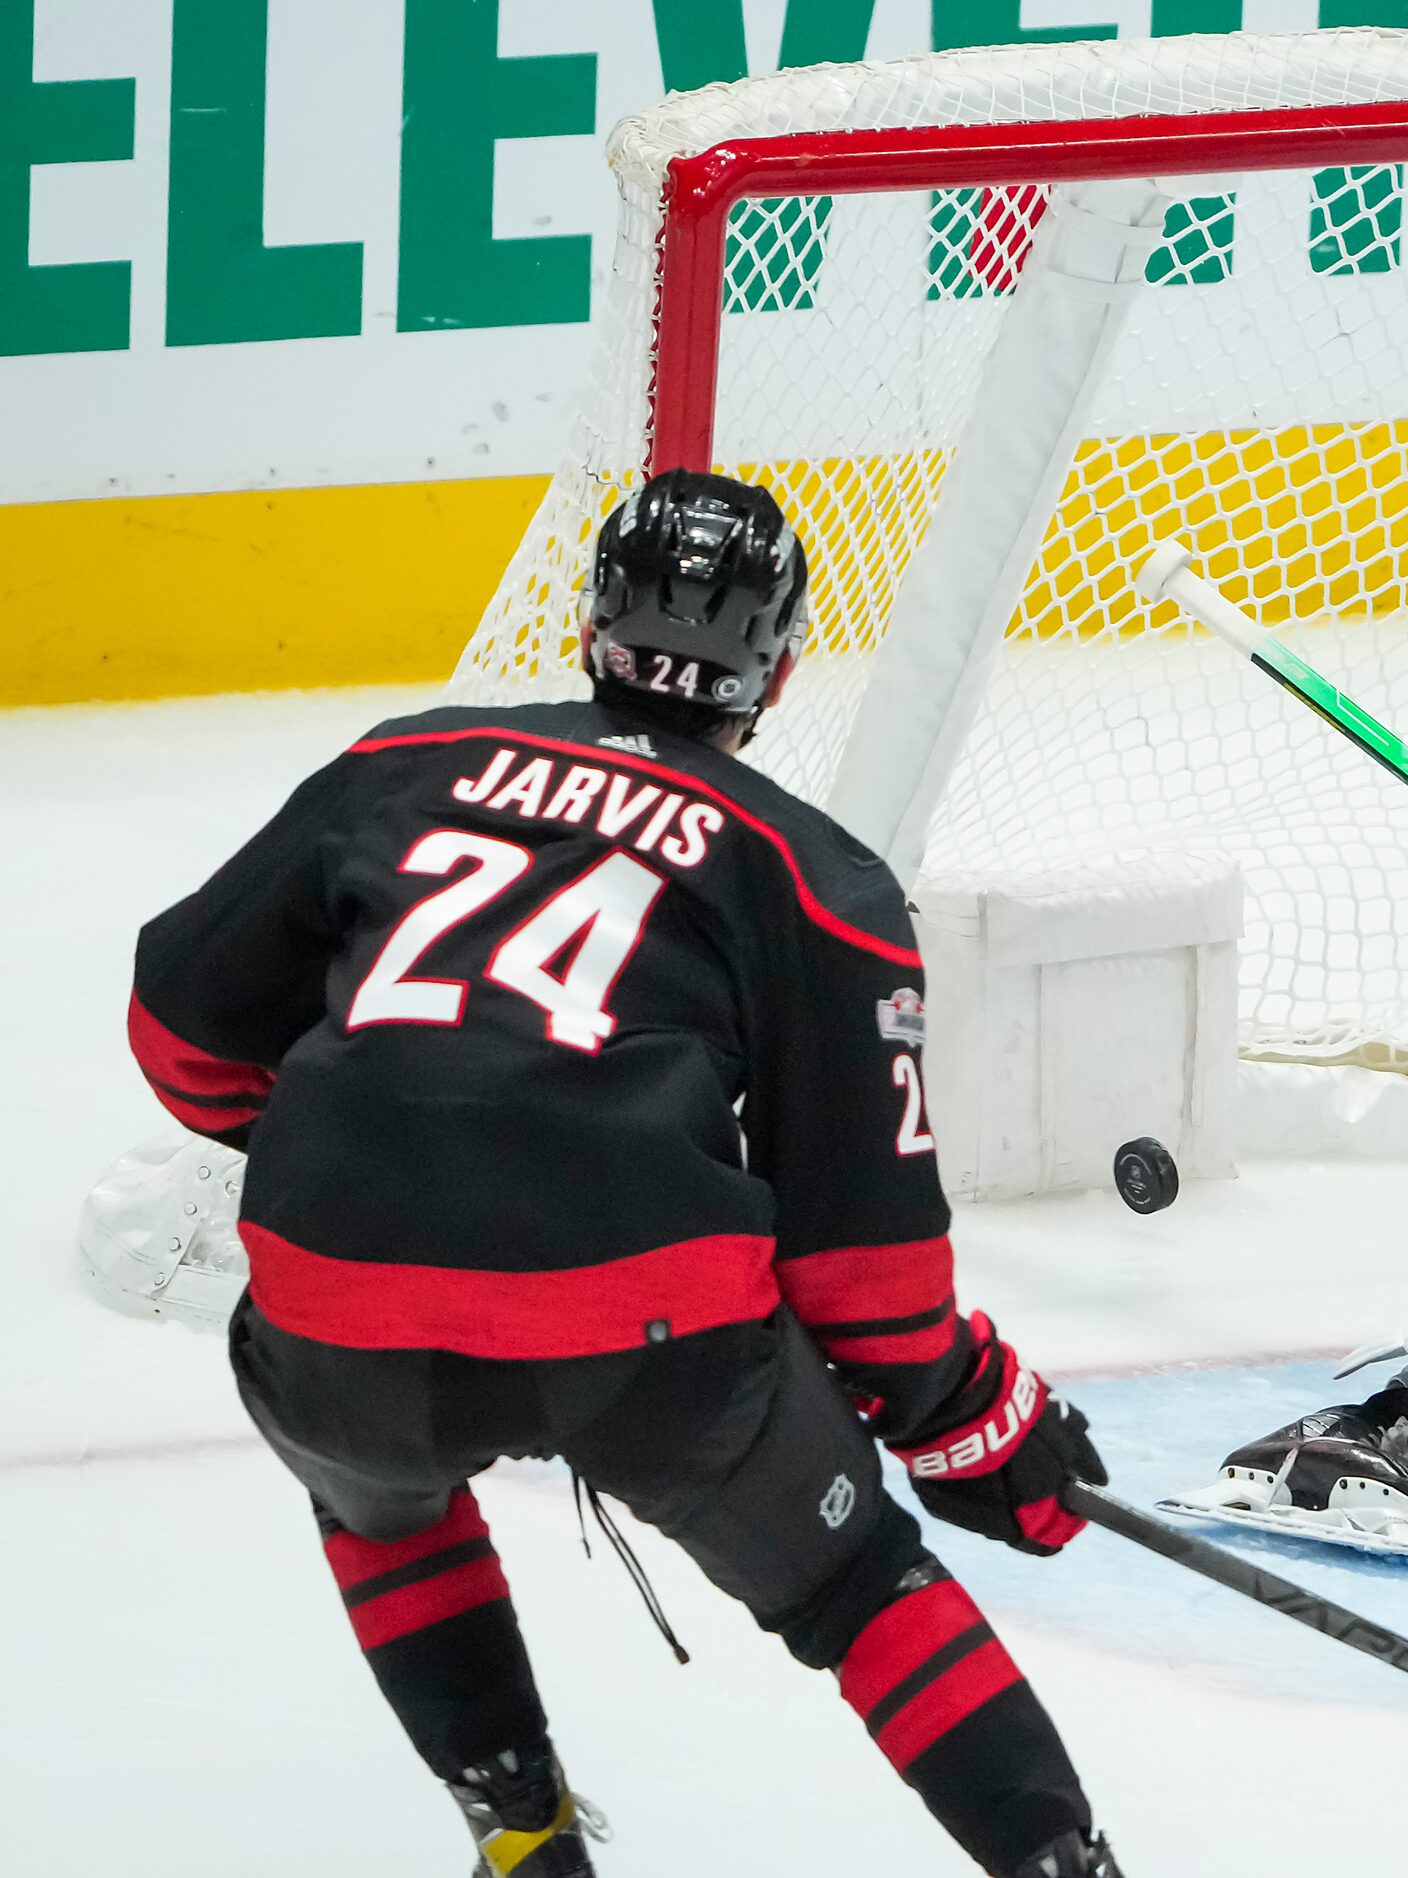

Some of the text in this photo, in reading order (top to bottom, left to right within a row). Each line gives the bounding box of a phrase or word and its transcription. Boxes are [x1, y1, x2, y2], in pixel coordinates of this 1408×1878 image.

[650, 654, 700, 698] 24
[451, 747, 725, 869] JARVIS
[346, 828, 669, 1056] 24
